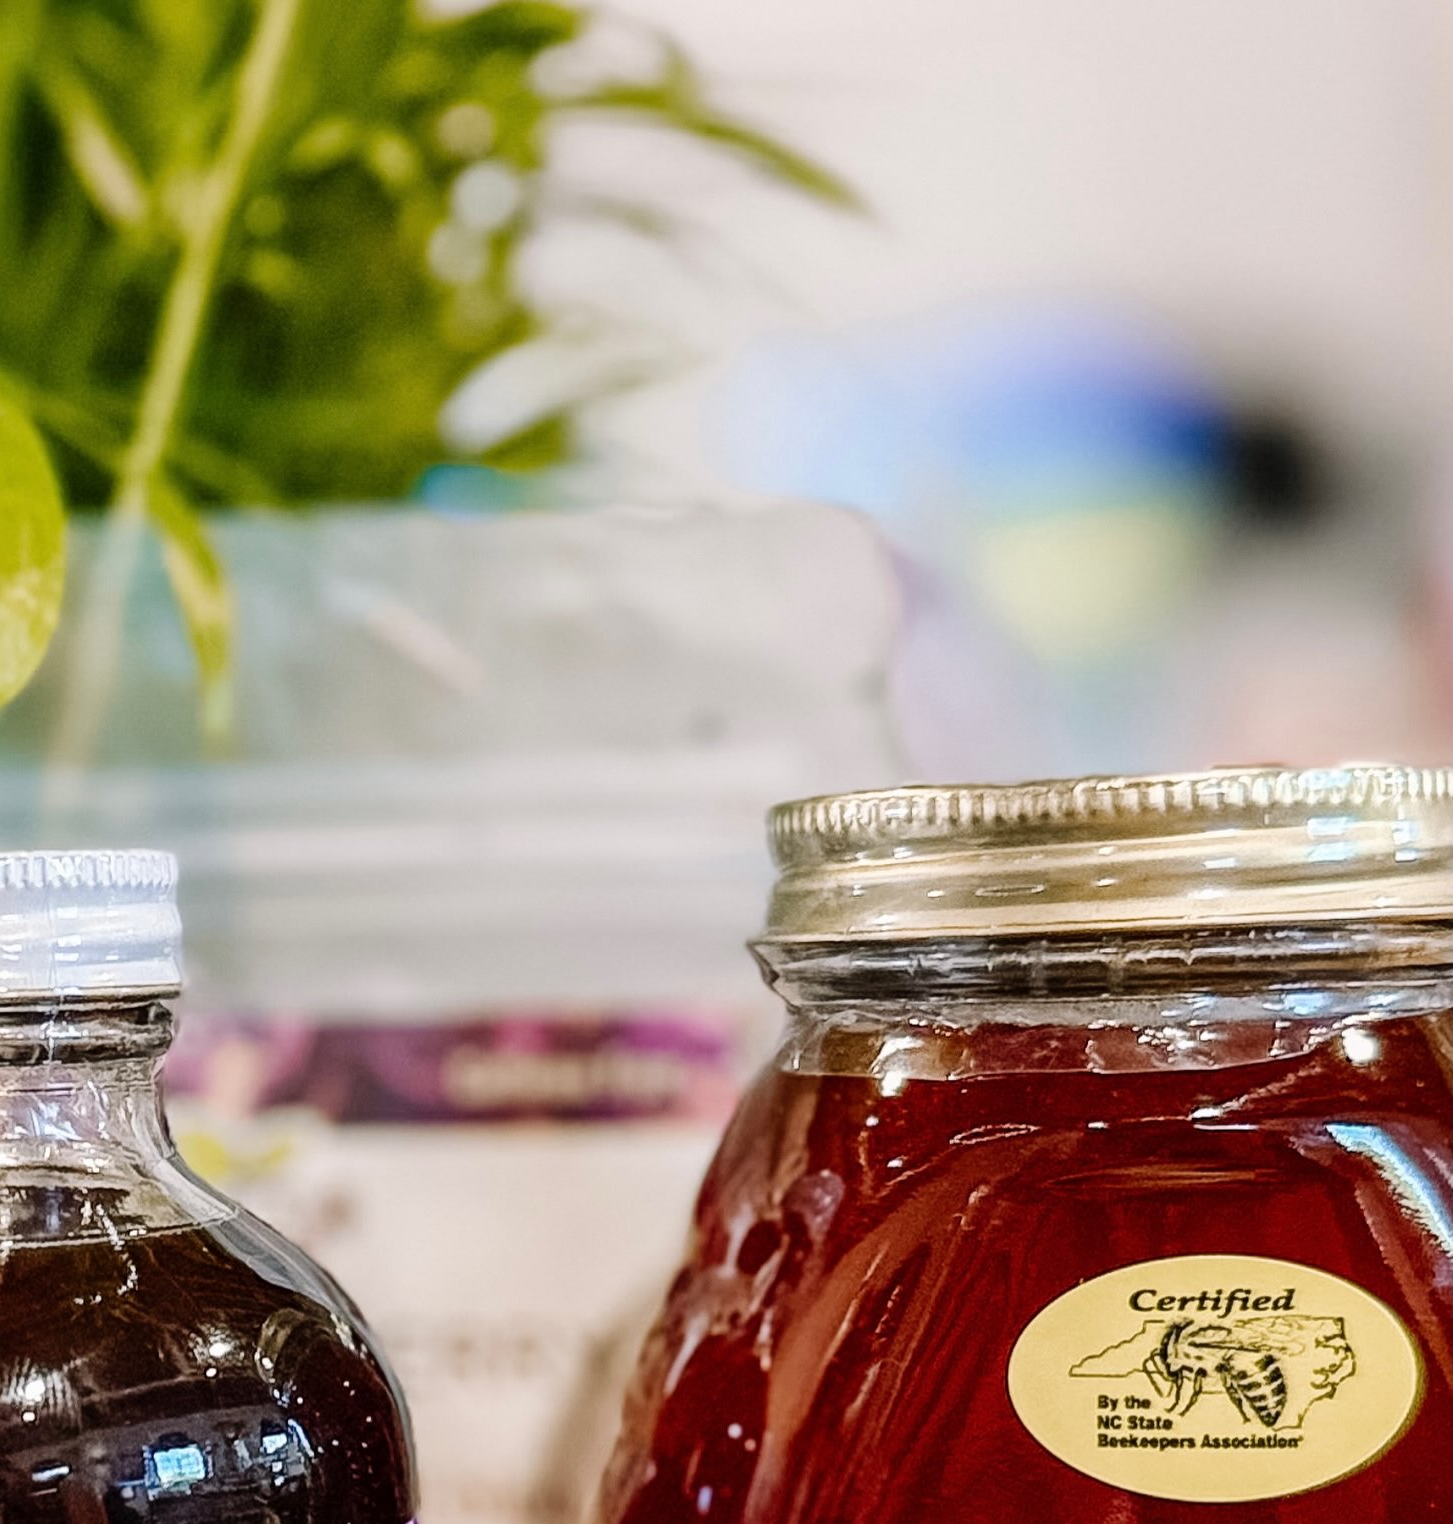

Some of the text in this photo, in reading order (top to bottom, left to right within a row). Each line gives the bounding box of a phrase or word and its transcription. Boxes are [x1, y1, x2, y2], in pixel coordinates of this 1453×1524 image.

[1129, 1288, 1296, 1318] Certified
[1098, 1395, 1150, 1411] By the
[1098, 1415, 1173, 1430] NC State
[1097, 1434, 1196, 1451] Beekeepers
